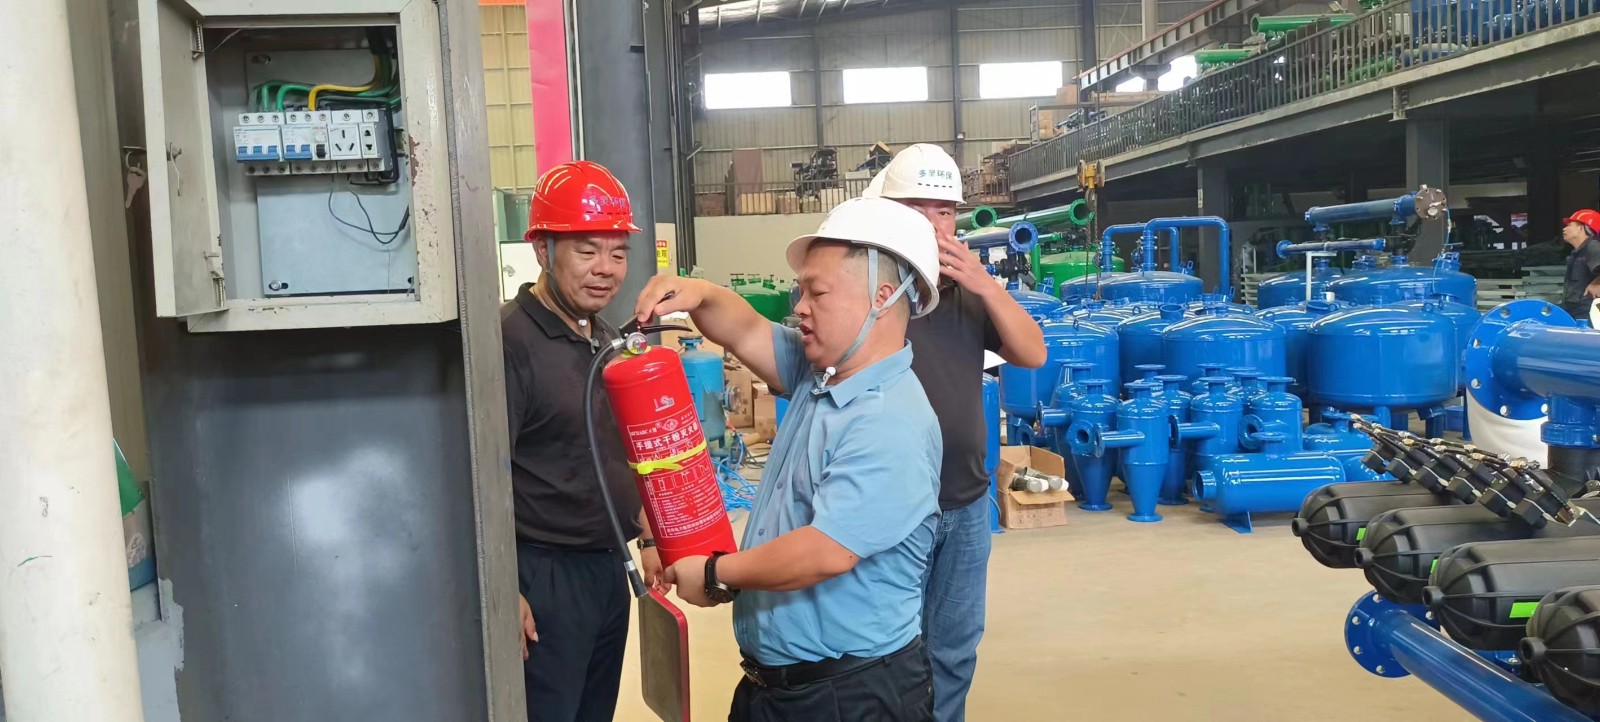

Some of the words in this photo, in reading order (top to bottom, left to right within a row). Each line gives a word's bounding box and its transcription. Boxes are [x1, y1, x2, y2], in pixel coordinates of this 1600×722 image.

[635, 420, 699, 451] 手提式干粉灭火器
